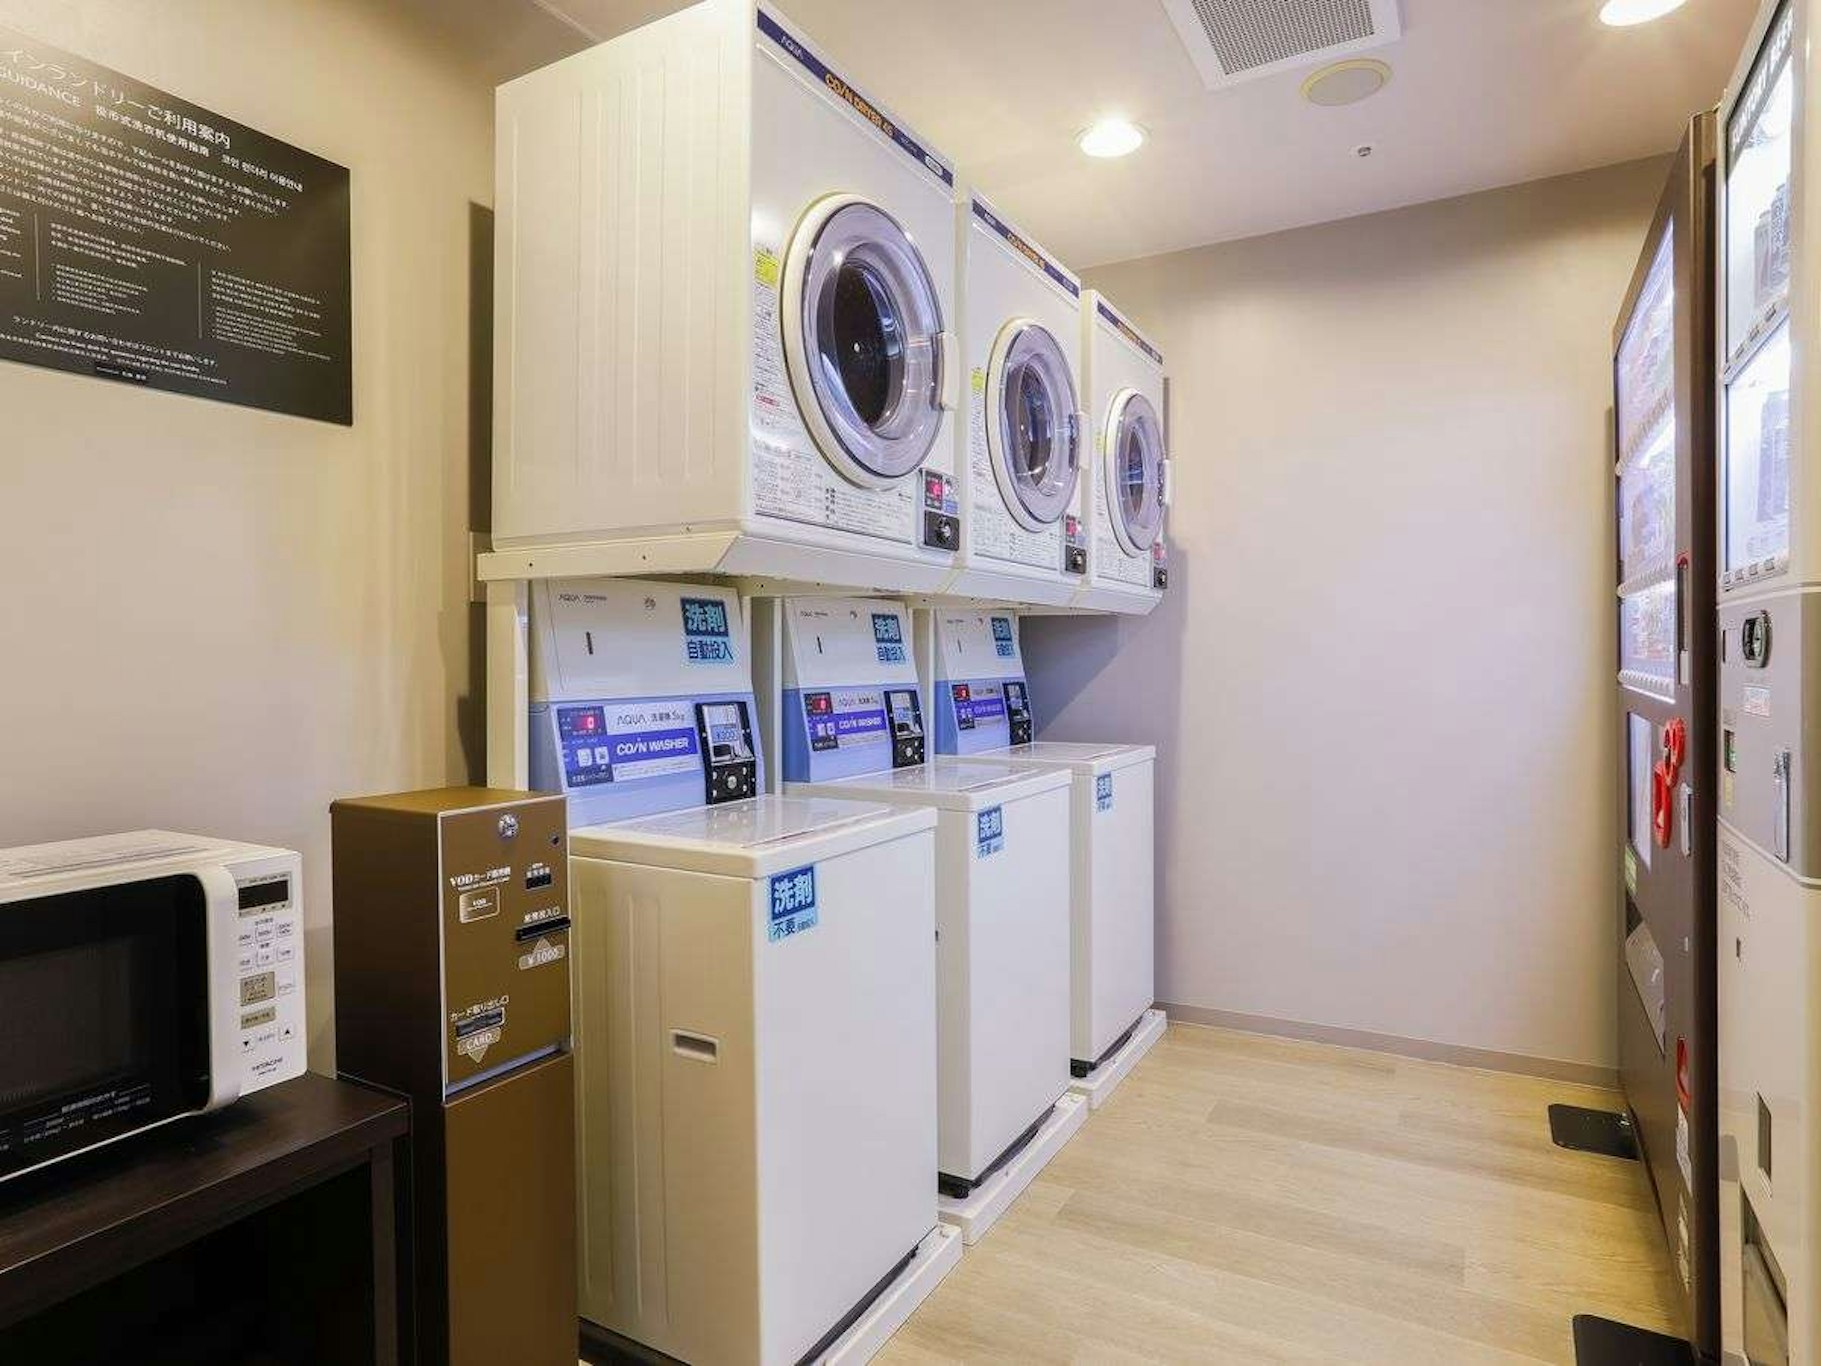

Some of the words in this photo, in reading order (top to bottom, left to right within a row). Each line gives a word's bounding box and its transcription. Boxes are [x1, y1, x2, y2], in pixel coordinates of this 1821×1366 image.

[685, 603, 726, 633] 洗剤
[687, 638, 734, 661] 自動投入
[616, 711, 648, 727] AQUA
[616, 738, 648, 757] COIN
[649, 736, 690, 753] WASHER
[978, 809, 1001, 838] 洗剤
[773, 872, 812, 914] 洗剤
[773, 917, 795, 939] 不要
[466, 1031, 493, 1049] CARD
